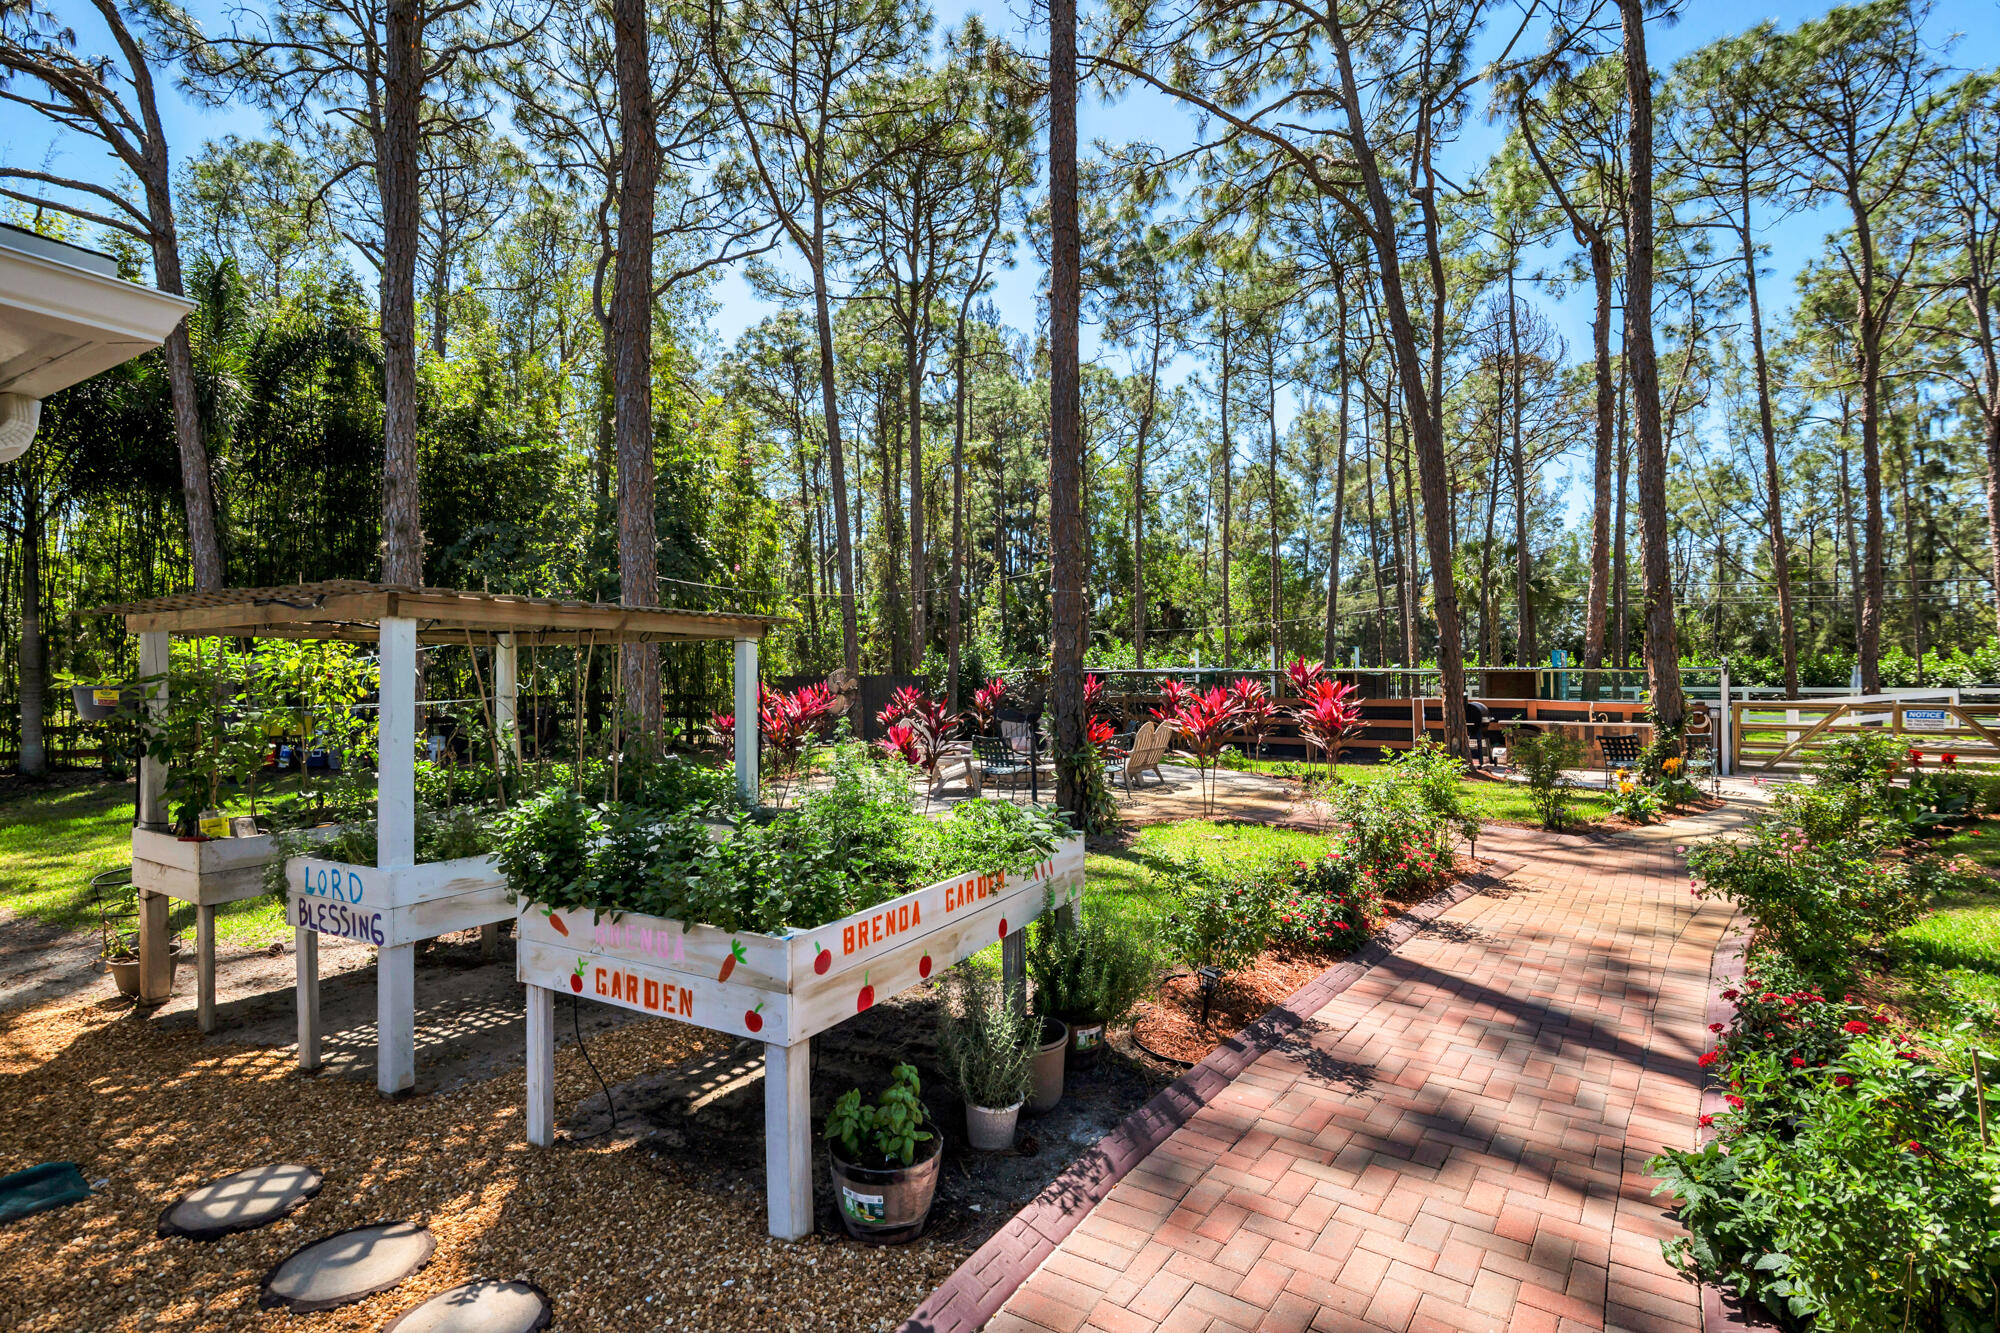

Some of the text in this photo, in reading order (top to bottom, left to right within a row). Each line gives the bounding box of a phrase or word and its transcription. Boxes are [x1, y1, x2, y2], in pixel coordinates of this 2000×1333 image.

[305, 866, 363, 904] LORD
[299, 898, 385, 946] BLESSING
[842, 869, 1006, 956] BRENDA GARDEN
[595, 919, 685, 961] BRENDA
[595, 967, 693, 1018] GARDEN
